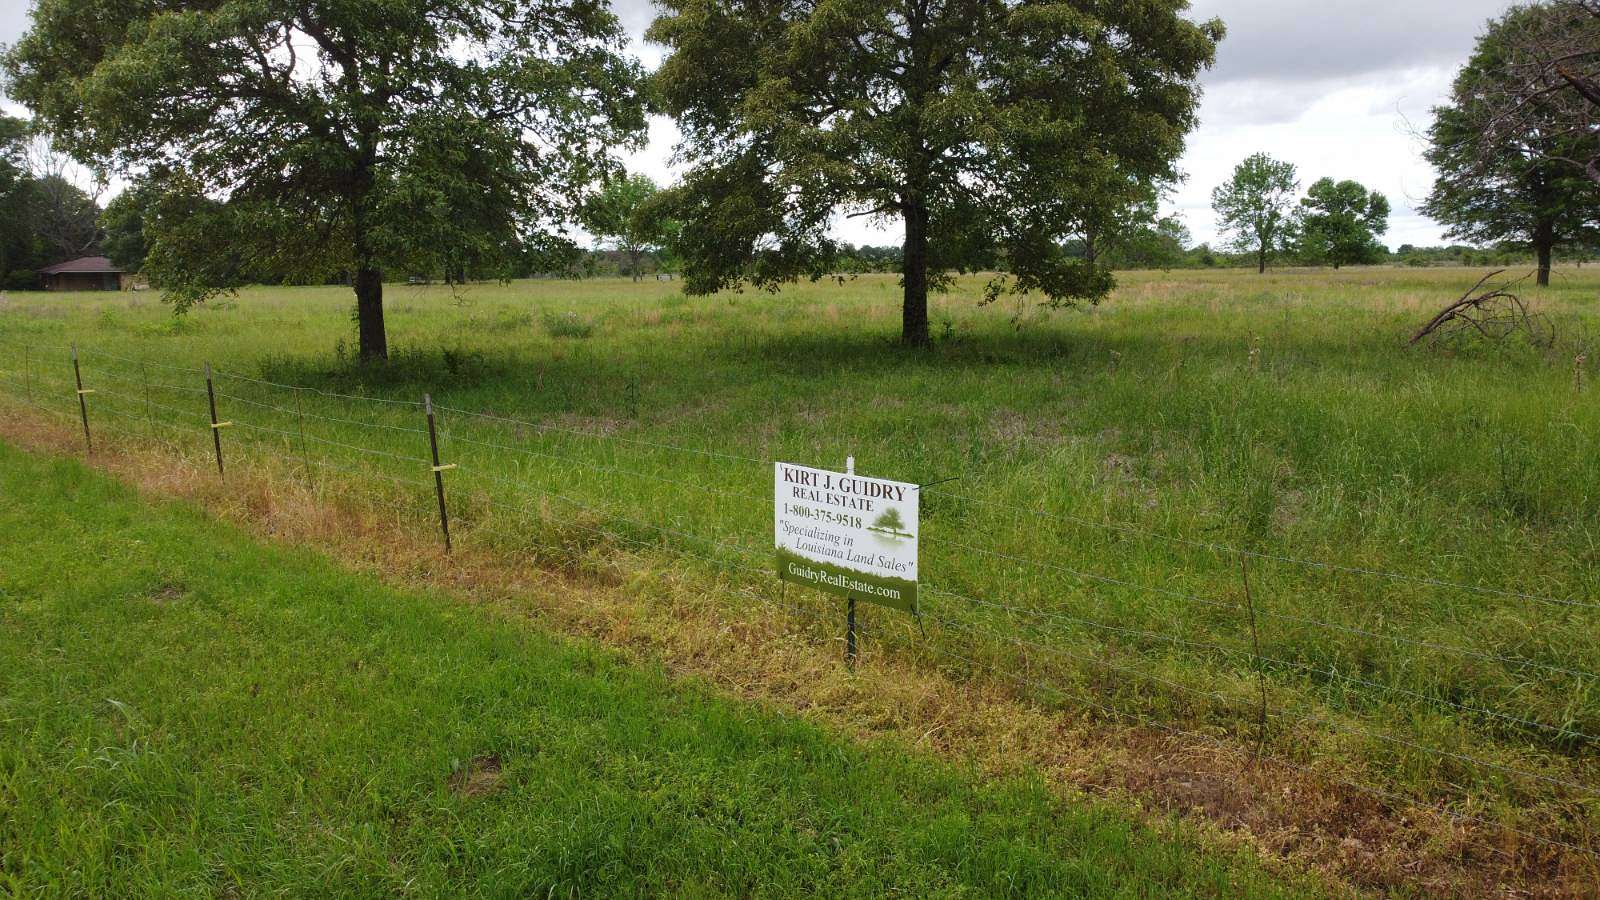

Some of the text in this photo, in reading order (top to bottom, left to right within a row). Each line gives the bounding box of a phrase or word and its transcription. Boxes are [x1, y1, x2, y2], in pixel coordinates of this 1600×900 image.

[784, 467, 906, 501] KIRT J. GUIDRY
[793, 487, 874, 512] REAL ESTATE
[784, 502, 862, 529] 1-800-375-9518
[780, 519, 854, 547] "Specializing in
[796, 538, 914, 572] Louisiana Land Sales"
[788, 562, 901, 600] GuidryRealEstate.com
